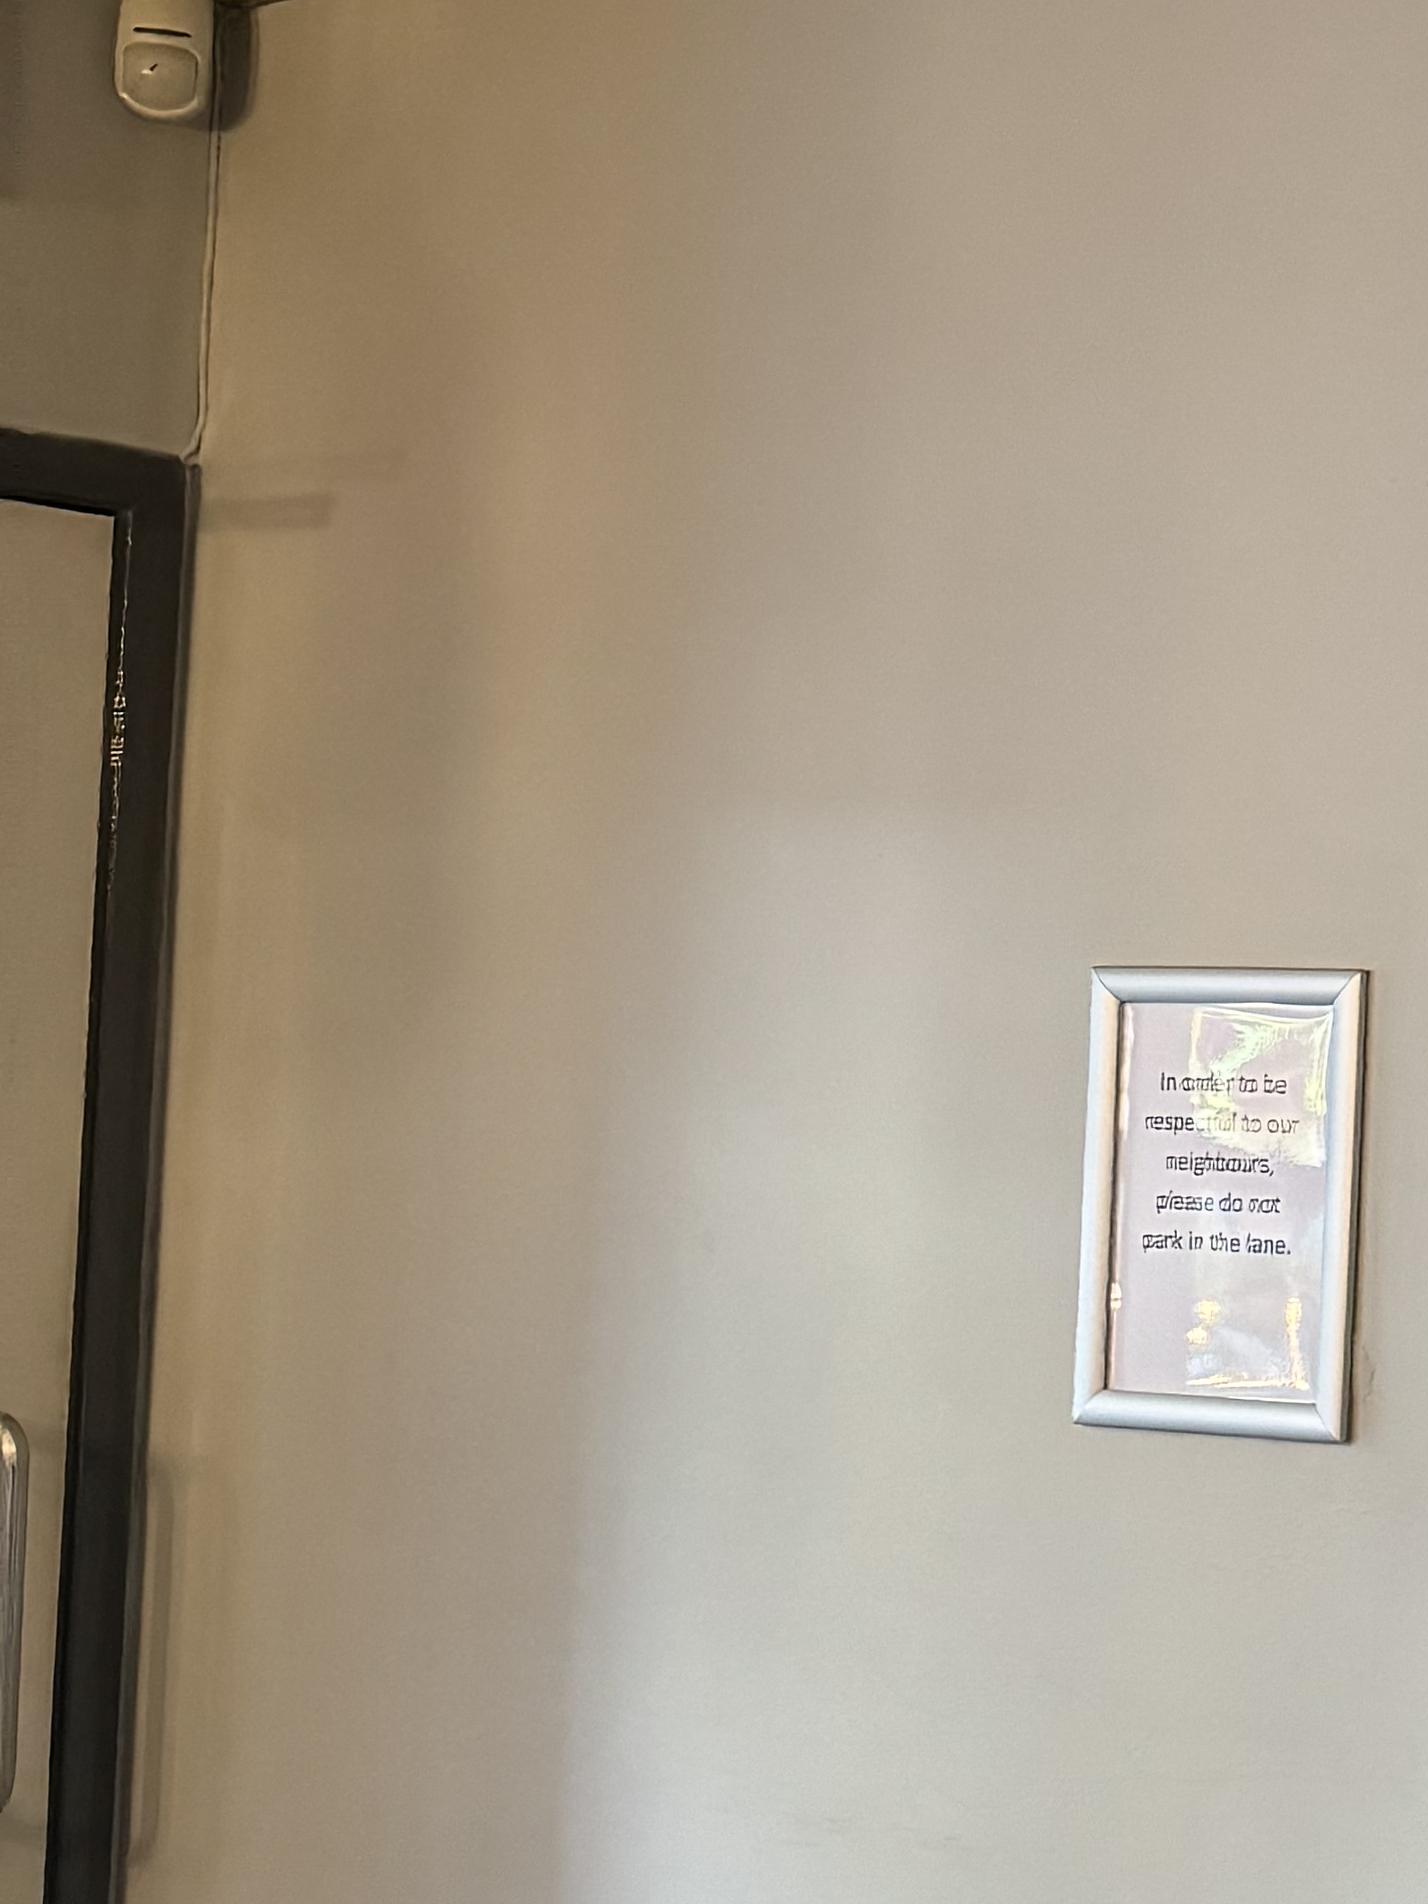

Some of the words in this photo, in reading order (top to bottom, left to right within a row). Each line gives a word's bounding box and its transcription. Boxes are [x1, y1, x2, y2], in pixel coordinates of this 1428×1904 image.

[1160, 1071, 1177, 1091] In
[1180, 1070, 1235, 1097] order
[1238, 1074, 1259, 1093] to
[1263, 1073, 1288, 1095] be
[1144, 1111, 1238, 1136] respectful
[1241, 1114, 1262, 1133] to
[1266, 1118, 1300, 1135] our
[1165, 1151, 1275, 1177] neighbours,
[1156, 1189, 1215, 1214] please
[1218, 1191, 1243, 1213] do
[1248, 1196, 1281, 1214] not
[1142, 1229, 1183, 1253] park
[1188, 1230, 1204, 1251] in
[1209, 1231, 1241, 1253] the
[1246, 1232, 1292, 1256] lane.
